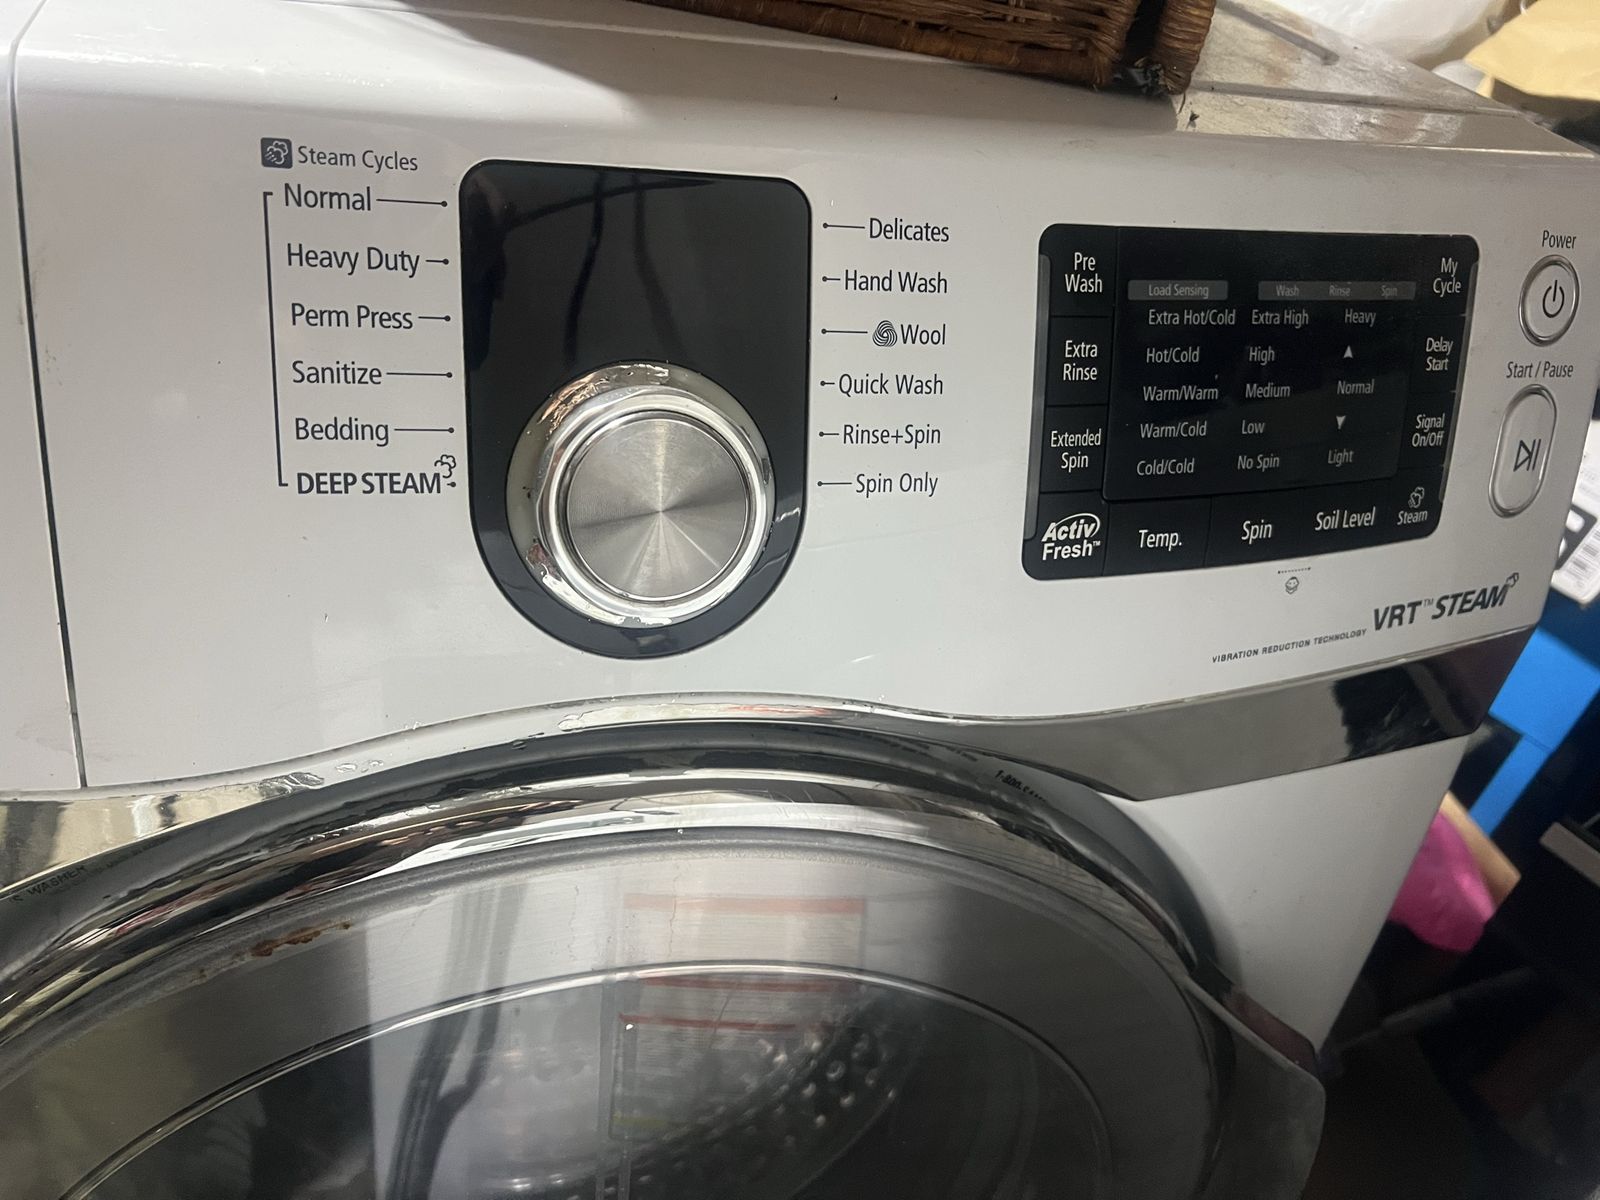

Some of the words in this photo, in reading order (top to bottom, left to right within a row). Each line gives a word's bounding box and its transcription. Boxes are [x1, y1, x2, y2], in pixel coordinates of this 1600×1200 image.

[298, 145, 356, 167] Steam
[362, 150, 418, 173] Cycles
[284, 183, 371, 211] Normal
[870, 217, 949, 242] Delicates
[1541, 230, 1576, 249] Power
[287, 243, 359, 276] Heavy
[367, 247, 420, 278] Duty
[1074, 252, 1096, 271] Pre
[1441, 257, 1458, 277] My
[845, 269, 892, 291] Hand
[898, 271, 947, 293] Wash
[1065, 273, 1103, 293] Wash
[1275, 285, 1299, 297] Wash
[1329, 285, 1350, 297] Rinse
[1433, 277, 1462, 297] Cycle
[1149, 284, 1171, 296] Load
[1173, 284, 1209, 299] Sensing
[1381, 285, 1397, 298] Spin
[291, 302, 349, 327] Perm
[357, 305, 413, 329] Press
[1148, 309, 1180, 325] Extra
[1183, 308, 1236, 326] Hot/Cold
[1251, 309, 1280, 325] Extra
[1283, 309, 1309, 329] High
[1344, 308, 1376, 327] Heavy
[900, 323, 946, 345] Wool
[1065, 340, 1098, 358] Extra
[1146, 347, 1200, 363] Hot/Cold
[1249, 346, 1275, 366] High
[1425, 336, 1454, 356] Delay
[292, 360, 382, 384] Sanitize
[1063, 363, 1098, 381] Rinse
[1425, 356, 1449, 371] Start
[1506, 361, 1533, 379] Start
[1543, 361, 1574, 378] Pause
[839, 373, 889, 397] Quick
[896, 373, 943, 394] Wash
[1143, 385, 1219, 401] Warm/Warm
[1245, 382, 1291, 398] Medium
[1336, 379, 1375, 395] Normal
[295, 417, 389, 447] Bedding
[1140, 421, 1207, 438] Warm/Cold
[1241, 420, 1265, 435] Low
[1415, 413, 1446, 432] Signal
[843, 424, 941, 449] Rinse+Spin
[1050, 428, 1101, 447] Extended
[1412, 430, 1444, 448] On/Off
[1060, 451, 1088, 472] Spin
[1136, 458, 1195, 476] Cold/Cold
[1237, 455, 1253, 470] No
[1256, 453, 1280, 472] Spin
[1327, 449, 1354, 467] Light
[297, 472, 357, 494] DEEP
[361, 472, 441, 494] STEAM
[856, 473, 892, 498] Spin
[900, 471, 938, 497] Only
[1315, 509, 1339, 531] Soil
[1342, 506, 1376, 528] Level
[1397, 509, 1428, 526] Steam
[1041, 518, 1097, 542] Activ
[1139, 529, 1182, 551] Temp.
[1241, 519, 1273, 545] Spin
[1431, 583, 1510, 620] STEAM
[1212, 648, 1259, 663] VIBRATION
[1262, 639, 1310, 654] REDUCTION
[1314, 628, 1367, 645] TECHNOLOGY
